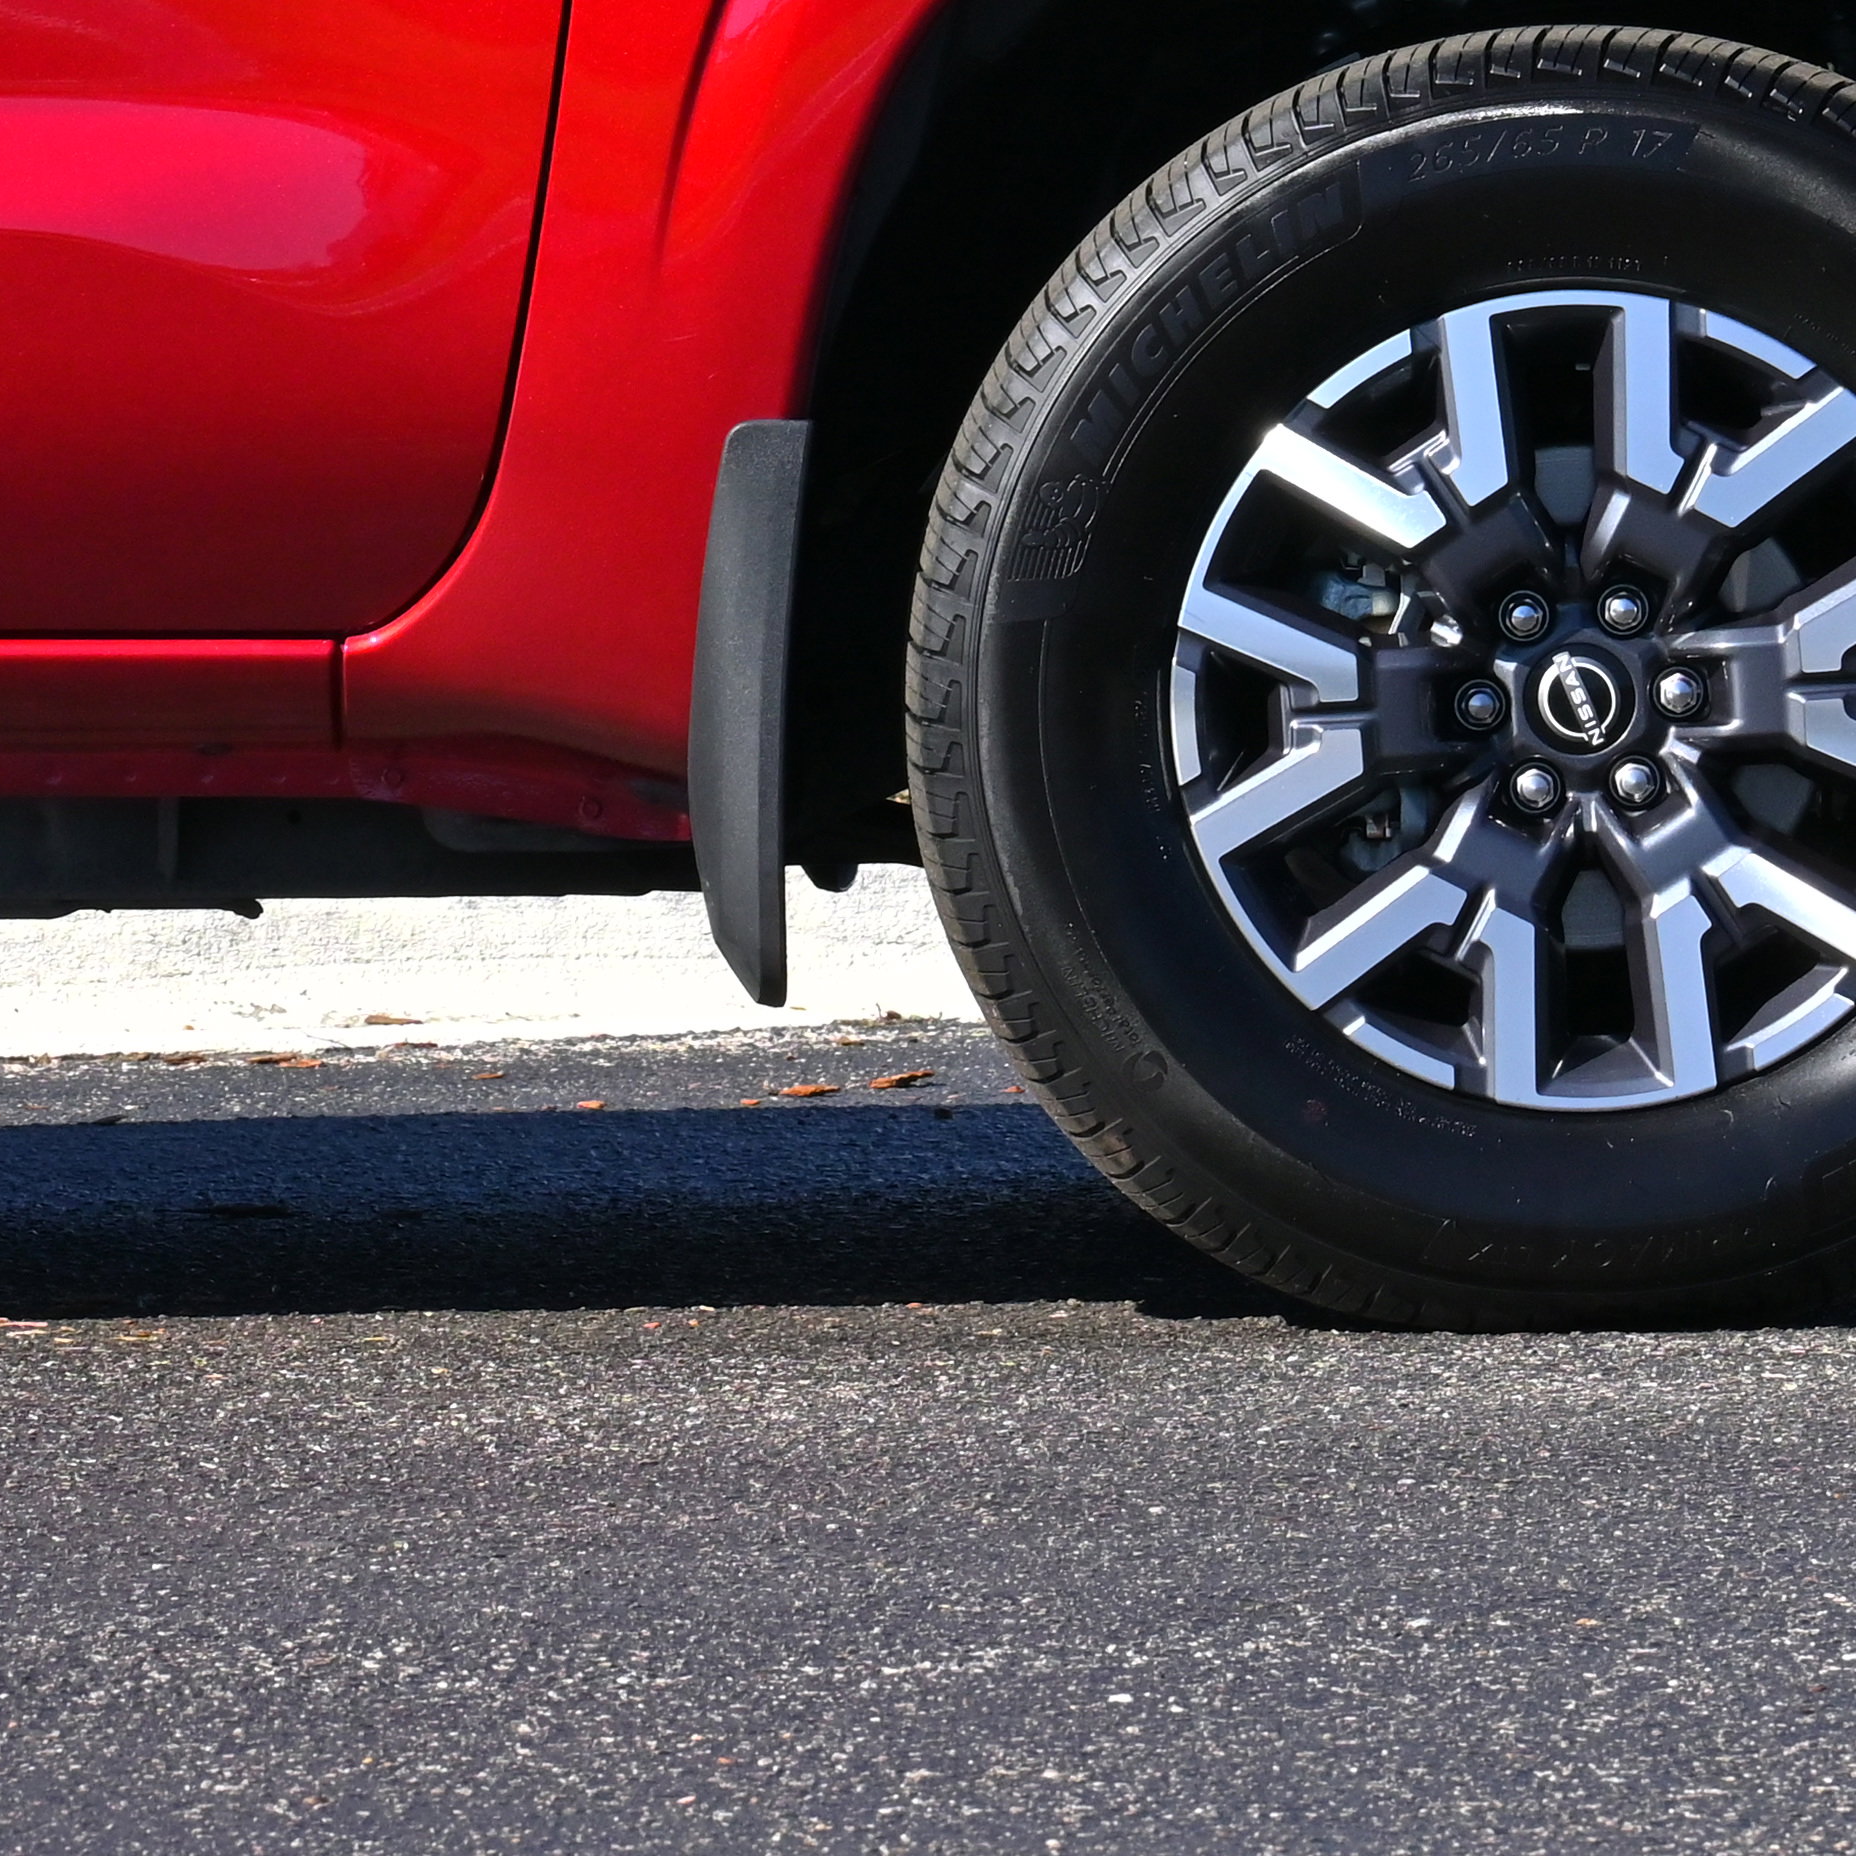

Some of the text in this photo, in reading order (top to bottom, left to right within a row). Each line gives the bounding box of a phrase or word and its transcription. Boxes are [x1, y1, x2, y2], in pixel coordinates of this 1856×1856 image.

[1397, 124, 1564, 184] 265/65
[1630, 127, 1674, 161] 17
[1067, 180, 1350, 469] MICHELIN
[1552, 651, 1606, 746] NISSAN
